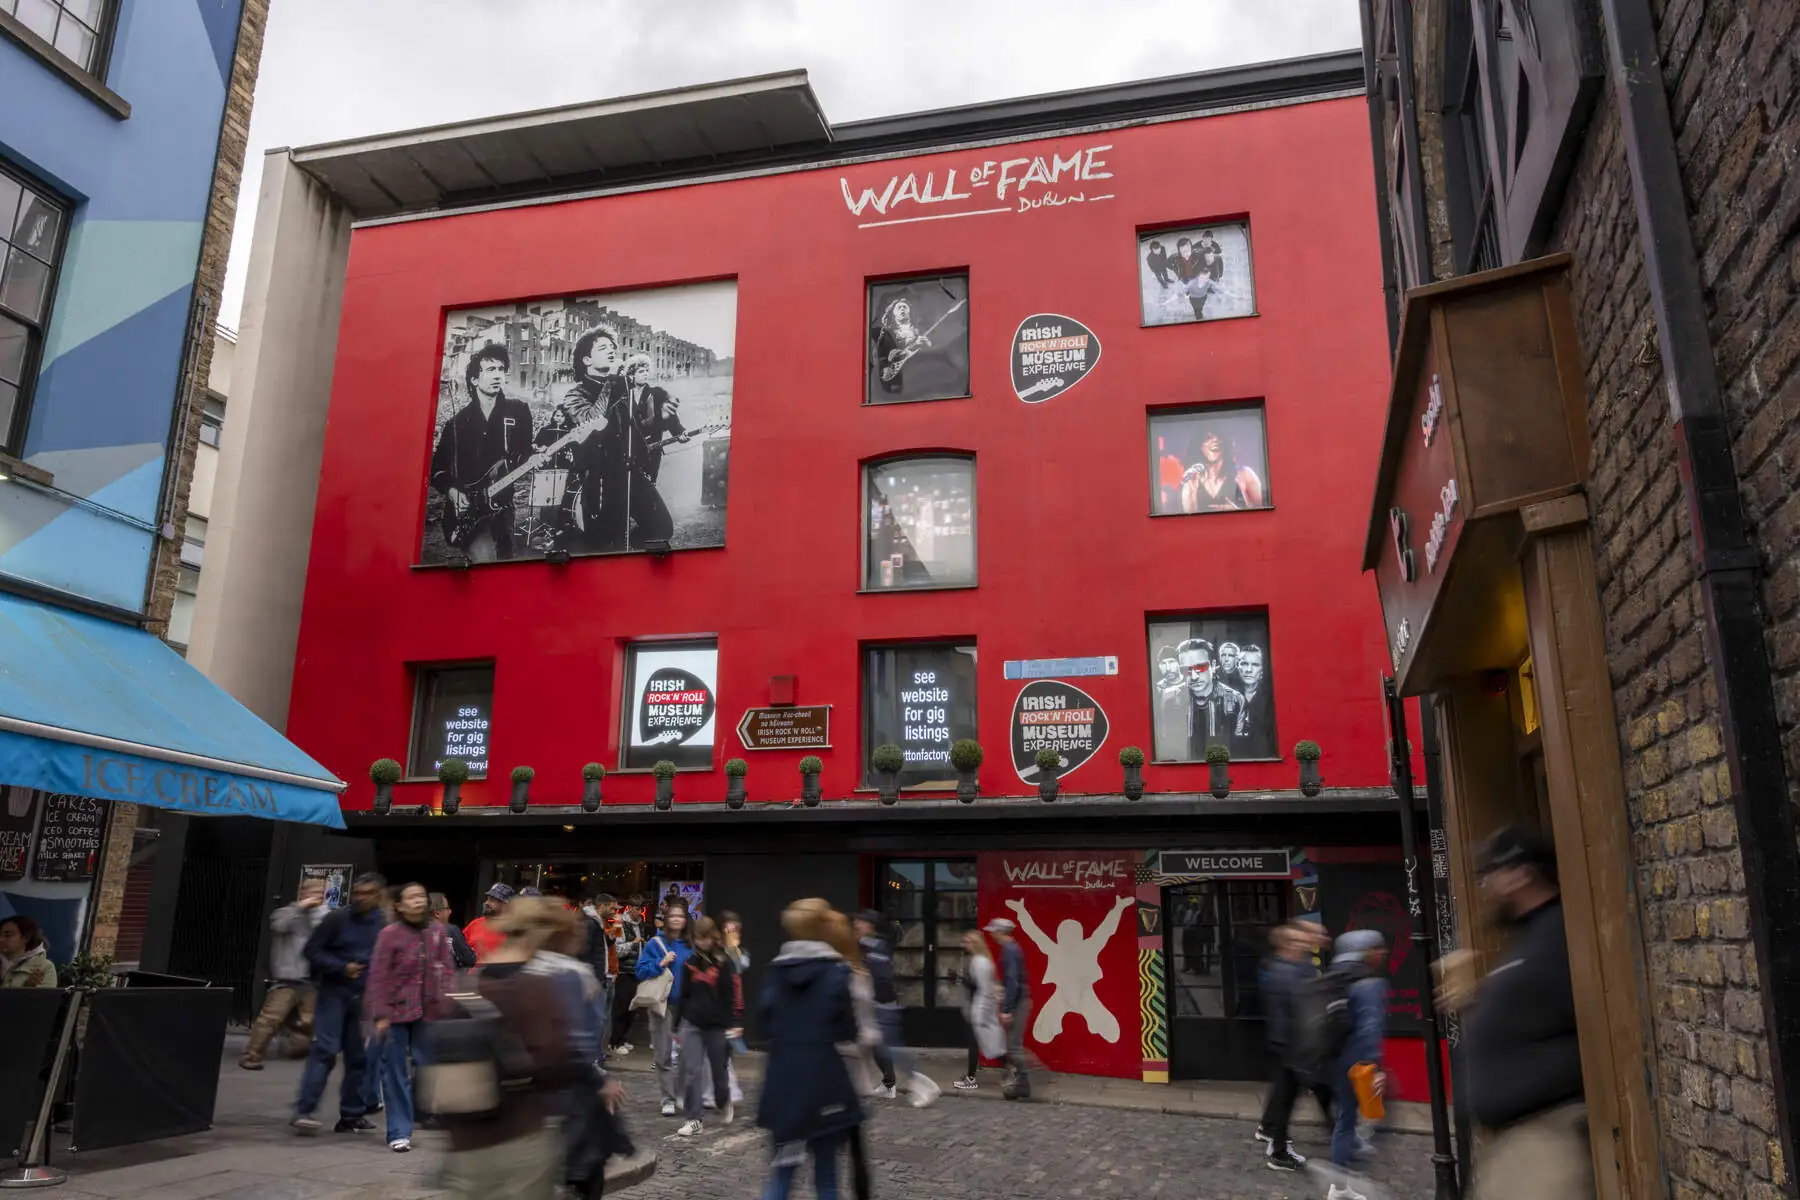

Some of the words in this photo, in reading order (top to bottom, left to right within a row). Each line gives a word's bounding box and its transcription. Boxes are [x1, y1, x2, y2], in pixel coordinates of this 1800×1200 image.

[840, 169, 972, 216] WALL
[970, 161, 998, 186] OF
[996, 145, 1114, 201] FAME
[1017, 191, 1085, 213] DUBLIN
[1021, 325, 1062, 341] IRISH
[1022, 348, 1085, 366] MUSEUM
[1022, 361, 1086, 377] EXPERIENCE
[914, 671, 936, 684] see
[650, 679, 685, 692] IRISH
[901, 688, 948, 703] website
[1022, 695, 1066, 711] IRISH
[458, 707, 478, 717] see
[648, 703, 703, 717] MUSEUM
[926, 706, 945, 724] gig
[446, 719, 488, 730] website
[648, 716, 702, 727] EXPERIENCE
[466, 731, 484, 744] gig
[760, 736, 786, 744] MUSEUM
[787, 735, 824, 744] EXPERIENCE
[905, 725, 949, 742] listings
[1022, 724, 1092, 740] MUSEUM
[446, 744, 486, 757] listings
[1023, 739, 1092, 752] EXPERIENCE
[82, 753, 143, 795] ICE
[154, 769, 279, 813] CREAM
[47, 793, 97, 812] CAKES
[1003, 859, 1064, 881] WALL
[1062, 860, 1075, 873] OF
[1075, 859, 1128, 882] FAME
[1185, 856, 1264, 870] WELCOME
